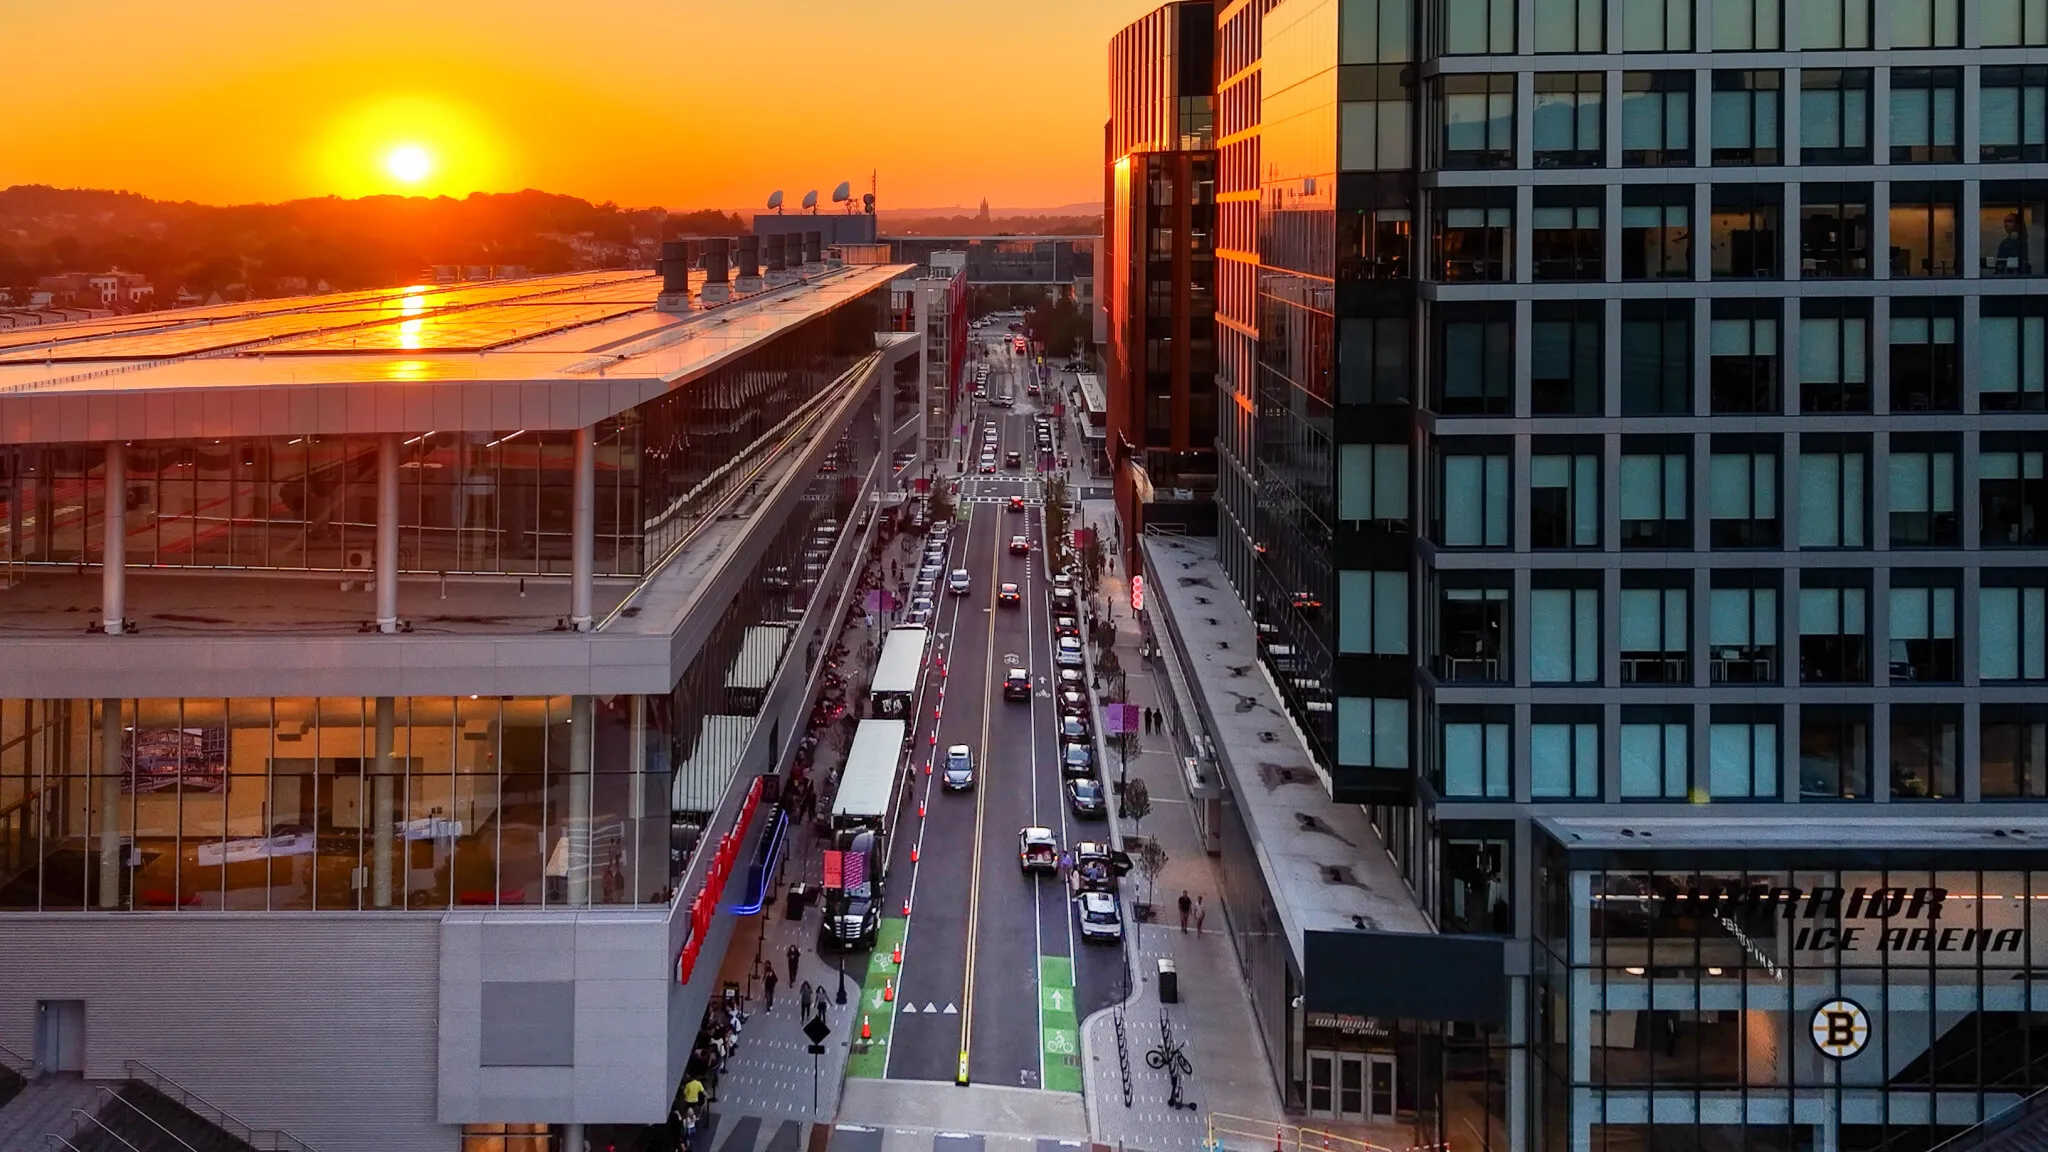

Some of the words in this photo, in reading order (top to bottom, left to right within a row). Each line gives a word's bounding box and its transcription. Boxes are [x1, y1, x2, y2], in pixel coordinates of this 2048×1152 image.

[1795, 927, 1865, 951] ICE
[1877, 927, 2024, 951] ARENA
[1827, 1012, 1854, 1046] B
